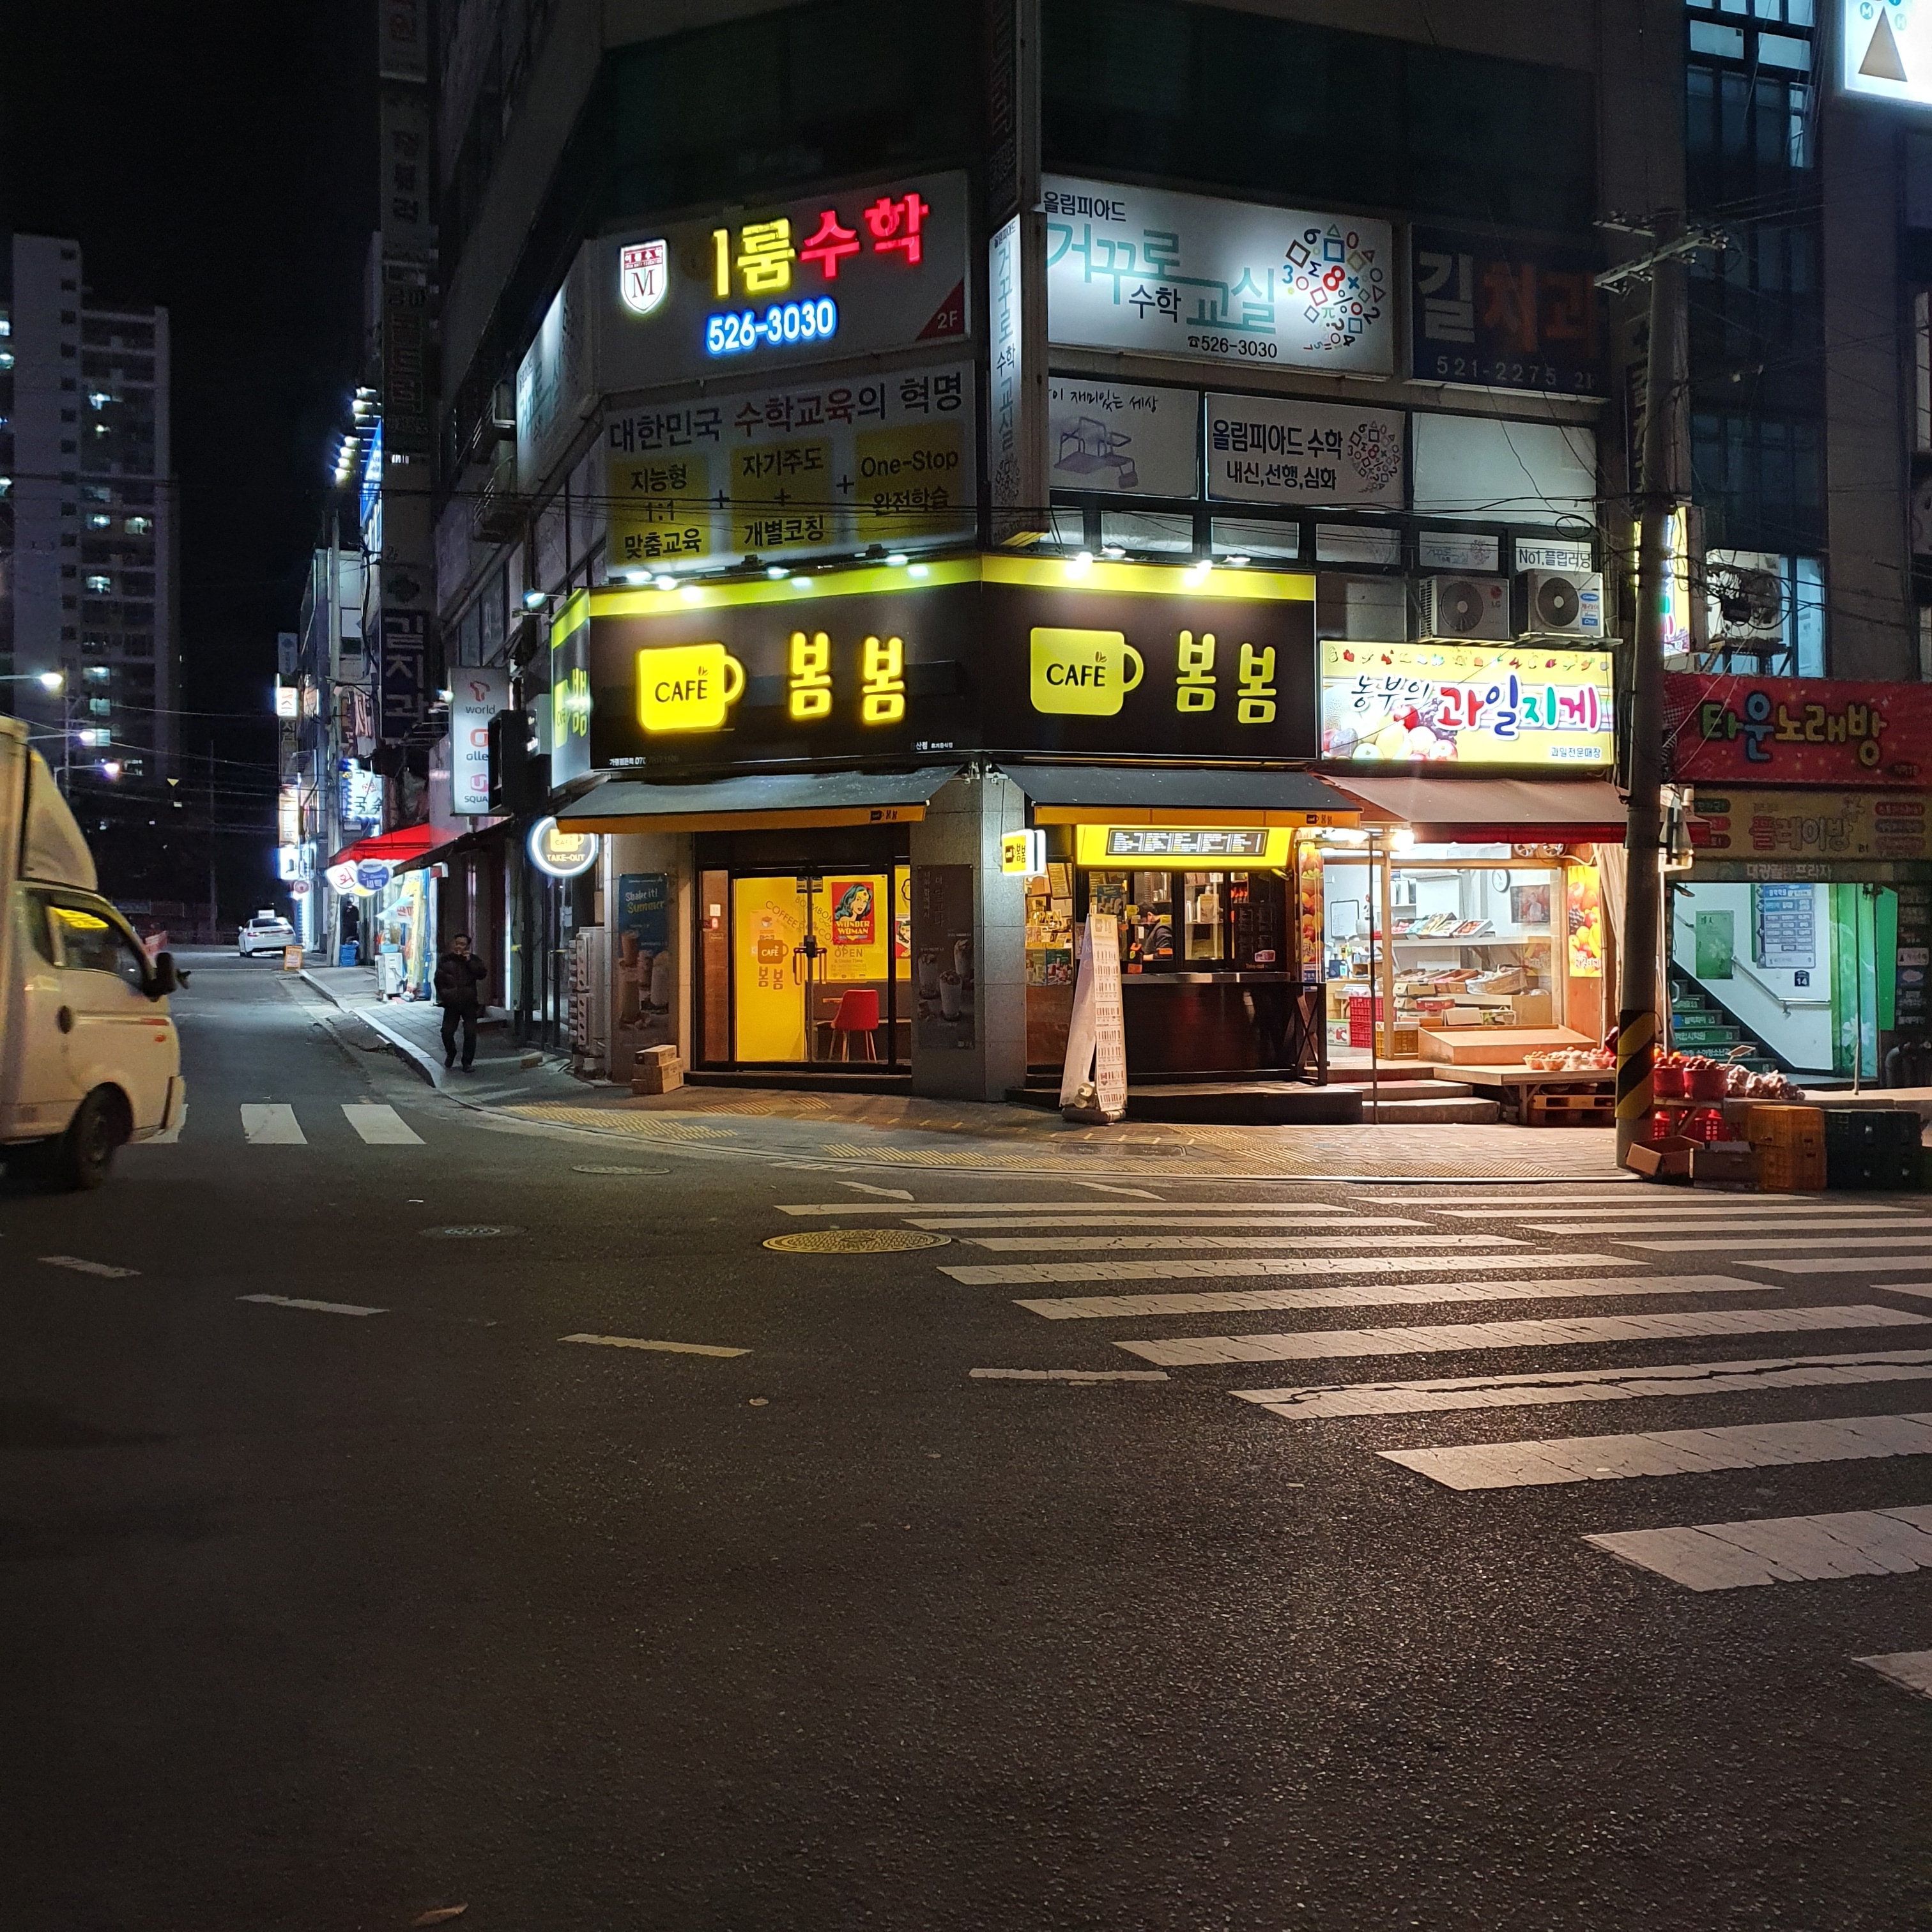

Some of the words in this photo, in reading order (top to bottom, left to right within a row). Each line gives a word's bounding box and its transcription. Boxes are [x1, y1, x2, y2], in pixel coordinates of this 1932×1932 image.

[1043, 191, 1126, 224] 올림피아드
[1046, 222, 1181, 305] 거꾸로
[631, 269, 656, 298] M
[1128, 285, 1181, 323] 수학
[1186, 266, 1276, 335] 교실
[709, 300, 835, 353] 526-3030
[937, 310, 958, 330] 2F
[996, 345, 1016, 371] 수학
[1201, 335, 1278, 358] 526-3030
[1436, 355, 1557, 386] 521-2275
[609, 405, 723, 454] 대한민국
[733, 383, 887, 437] 수학교육의
[899, 371, 962, 413] 혁명
[1070, 390, 1124, 411] 재미있는
[1129, 395, 1159, 414] 세상
[1213, 419, 1303, 457] 올림피아드
[1307, 431, 1343, 460] 수학
[742, 446, 824, 479] 자기주도
[860, 448, 959, 478] One-Stop
[630, 463, 687, 494] 지능형
[872, 486, 951, 516] 완전학습
[624, 528, 702, 560] 맞춤교육
[744, 514, 825, 548] 개별코칭
[1046, 662, 1107, 688] CAFE
[655, 678, 709, 703] CAFE
[1351, 675, 1430, 709] 농부의
[1438, 674, 1598, 737] 과일지게
[465, 705, 496, 714] world
[1700, 693, 1888, 767] 타운노래방
[466, 751, 489, 761] olle
[464, 795, 489, 804] SQUA
[546, 854, 586, 862] TAKE-OUT
[625, 889, 647, 902] Shake
[627, 900, 666, 914] Summer
[765, 900, 801, 930] COFFEE
[762, 948, 779, 956] CAFE
[834, 948, 863, 958] OPEN
[1796, 977, 1807, 986] 14
